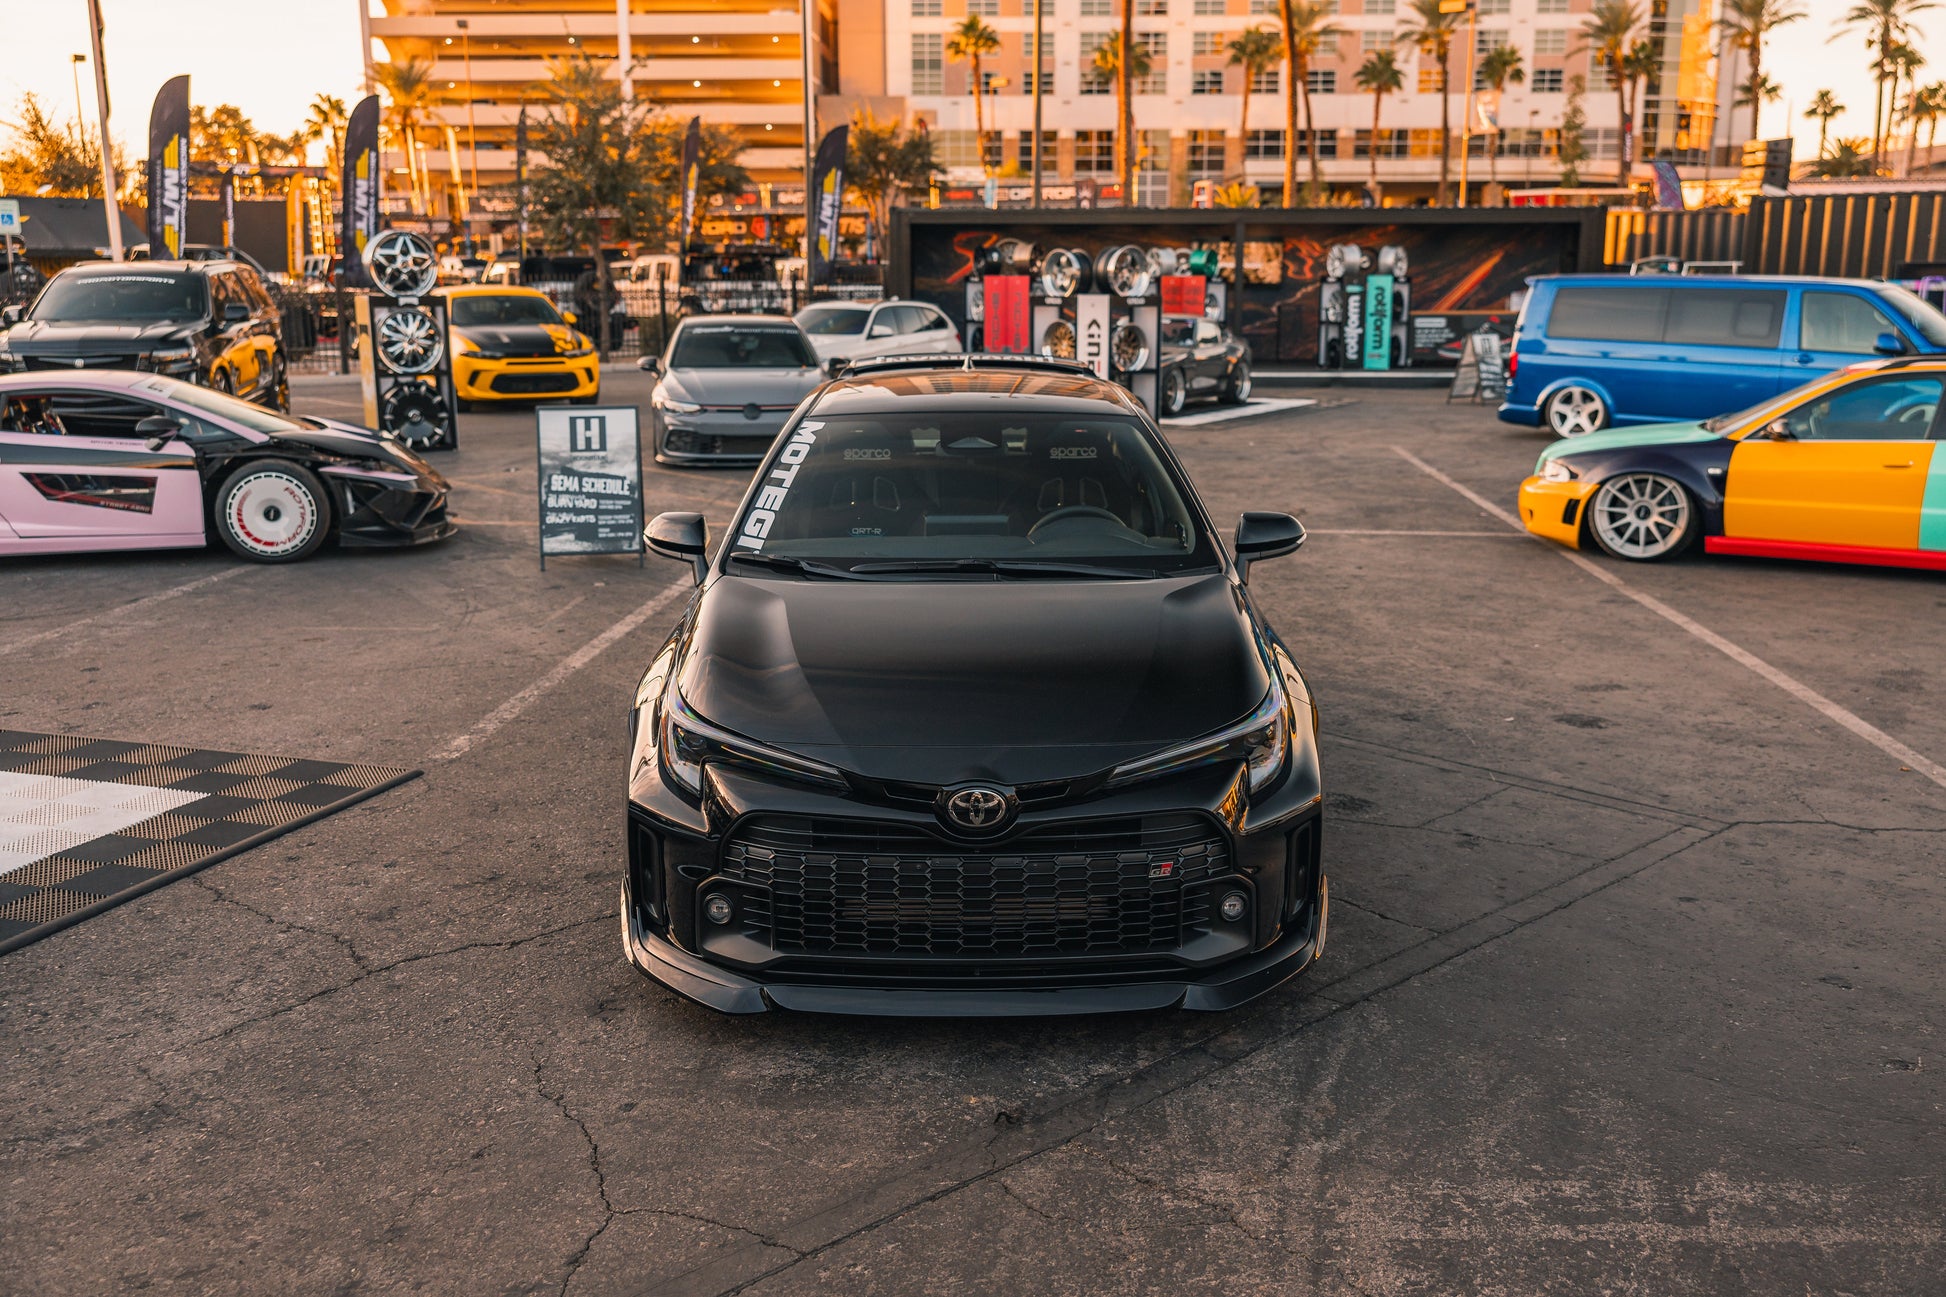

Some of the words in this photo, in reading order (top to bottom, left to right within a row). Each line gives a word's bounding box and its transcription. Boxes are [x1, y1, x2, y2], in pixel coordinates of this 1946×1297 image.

[163, 168, 180, 232] M/T
[1344, 294, 1364, 360] rotiform
[1369, 286, 1387, 350] rotiform
[576, 418, 600, 450] H
[843, 448, 891, 460] sparco
[1050, 446, 1097, 459] sparco
[551, 475, 579, 491] SEMA
[582, 478, 630, 494] SCHEDULE
[737, 421, 826, 550] MOTEGI
